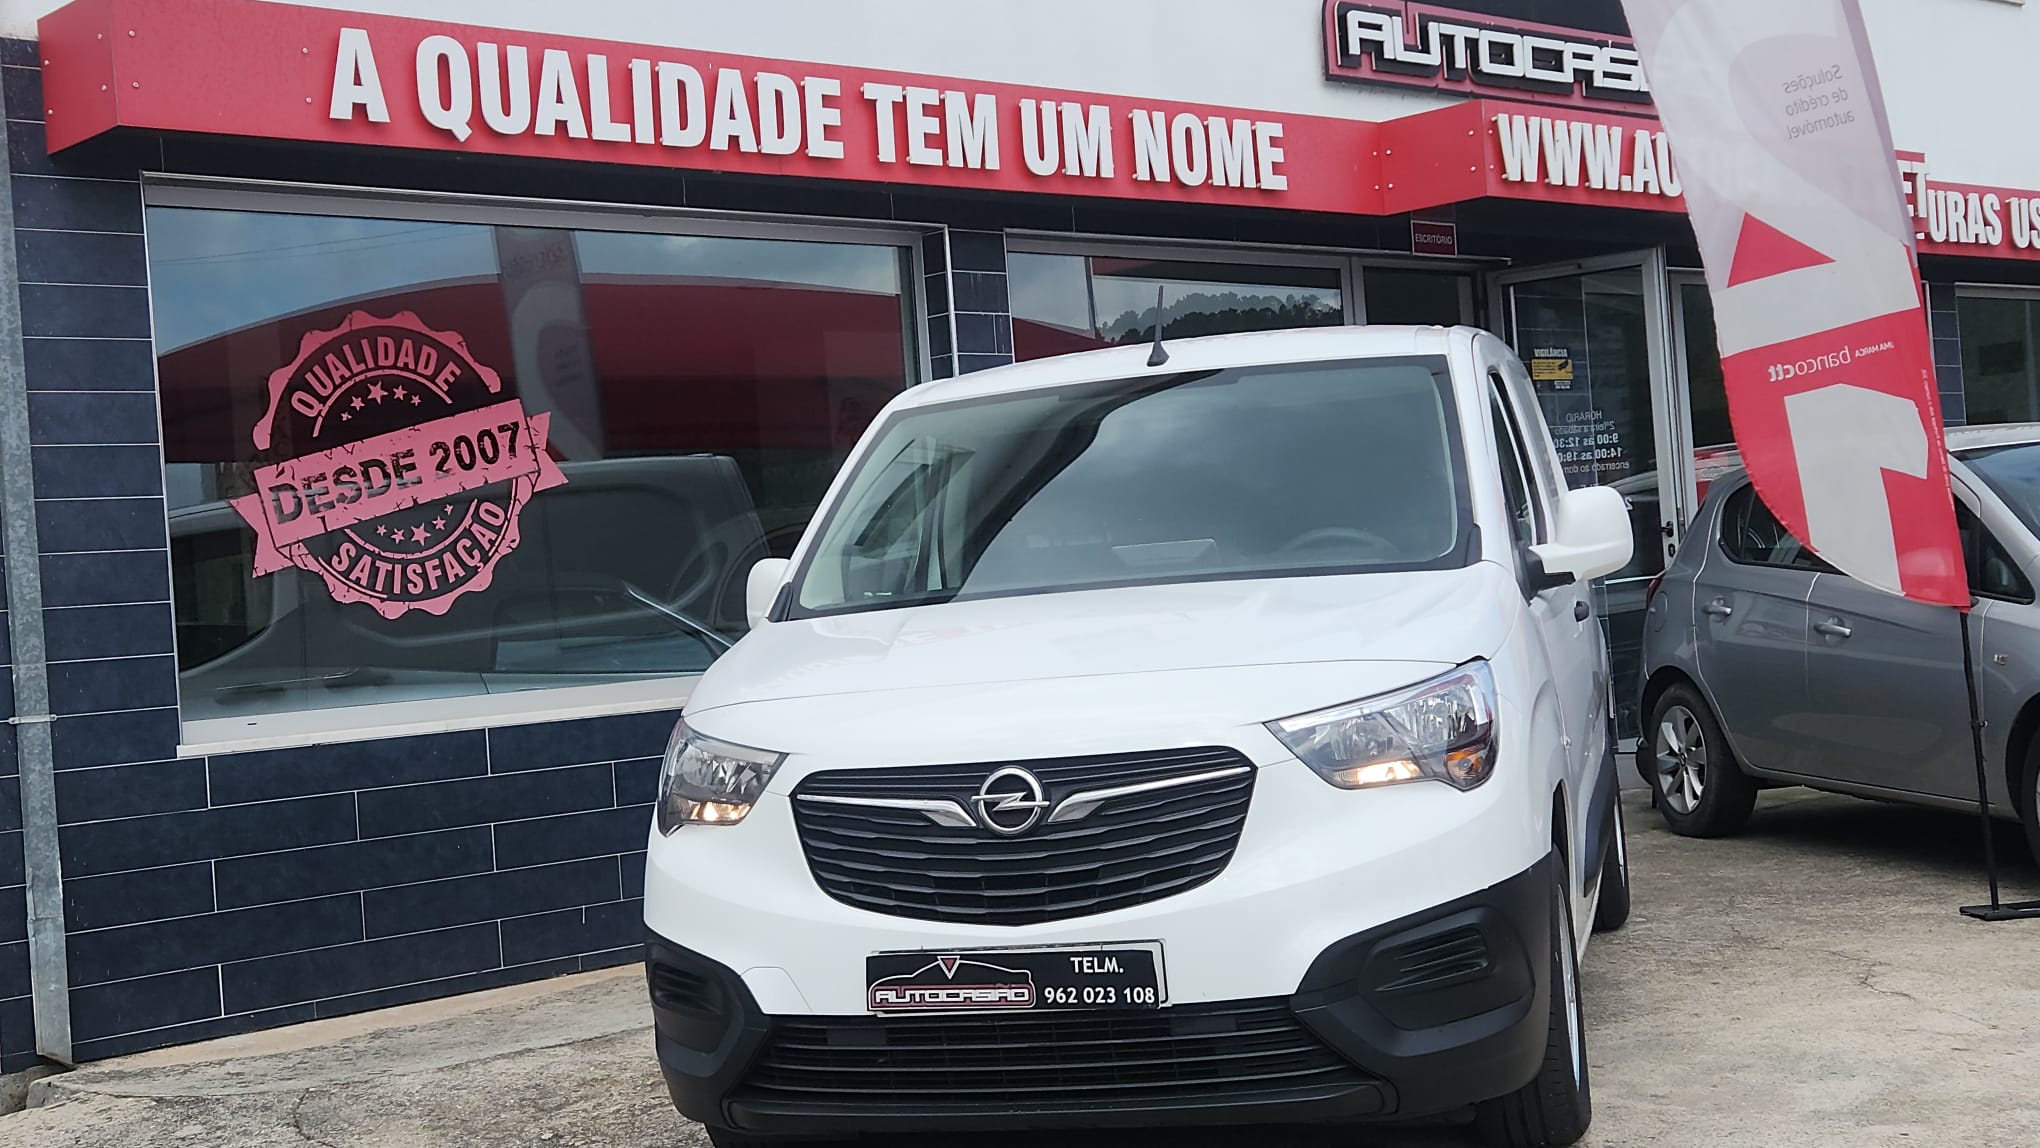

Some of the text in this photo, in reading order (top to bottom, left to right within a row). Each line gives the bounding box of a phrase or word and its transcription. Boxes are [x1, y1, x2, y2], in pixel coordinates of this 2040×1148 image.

[1347, 10, 1650, 92] AUTOCAS
[329, 27, 1289, 191] A QUALIDADE TEM UM NOME
[1497, 113, 1683, 197] WWW.AU
[291, 336, 461, 418] QUALIDADE
[267, 421, 521, 524] DESDE 2007
[1044, 987, 1155, 1004] 962 023 108
[1070, 957, 1124, 974] TELM.
